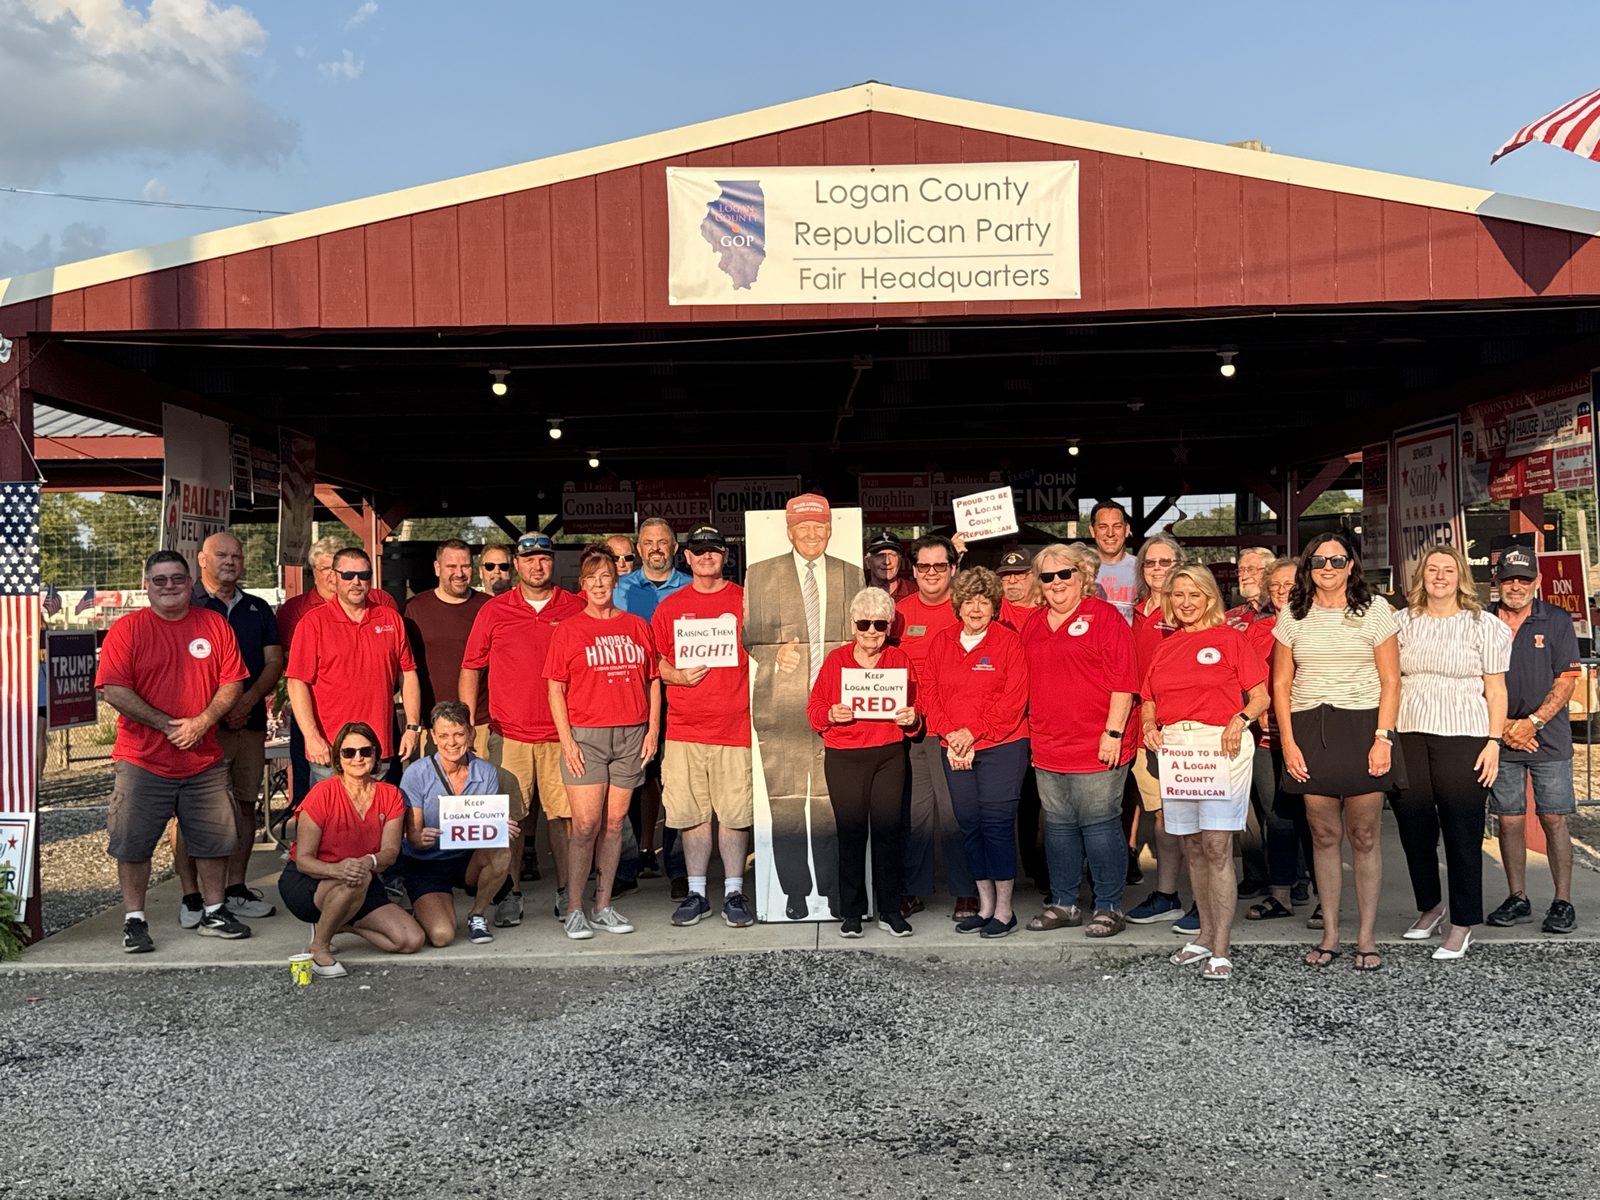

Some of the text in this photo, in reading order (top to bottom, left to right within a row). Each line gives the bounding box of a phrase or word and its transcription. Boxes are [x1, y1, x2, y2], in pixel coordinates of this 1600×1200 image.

[815, 176, 1029, 209] Logan County
[718, 204, 754, 213] LOGAN
[715, 213, 758, 222] COUNTY
[720, 235, 755, 247] GOP
[794, 217, 1051, 251] Republican Party
[799, 263, 1050, 293] Fair Headquarters
[1541, 412, 1573, 432] Landers
[1413, 445, 1433, 460] SENATOR
[1556, 444, 1592, 460] WRIGHT
[1034, 472, 1077, 487] JOHN
[1409, 464, 1439, 502] Sally
[183, 483, 229, 518] BAILEY
[564, 497, 633, 516] Conahan
[861, 490, 915, 512] Coughlin
[956, 497, 983, 508] PROUD
[638, 502, 708, 516] KNAUER
[965, 508, 972, 517] A
[968, 516, 1002, 527] COUNY
[181, 521, 198, 542] DEL
[963, 525, 1012, 540] REPUBLAN
[1402, 522, 1453, 561] TURNER
[1552, 579, 1573, 594] DON
[1547, 594, 1580, 612] TRACY
[677, 627, 734, 638] RAISING THEM
[595, 635, 634, 647] ANDREA
[585, 643, 645, 667] HINTON
[679, 643, 734, 658] RIGHT!
[51, 654, 94, 677] TRUMP
[864, 671, 885, 679] KEEP
[57, 676, 90, 695] VANCE
[844, 683, 904, 692] LOGAN COUNTY
[851, 696, 897, 712] RED
[1161, 747, 1194, 757] PROUD
[1171, 760, 1217, 770] A LOGAN
[1174, 774, 1215, 783] COUNTY
[1166, 786, 1225, 797] REPUBLICAN
[464, 799, 485, 807] KEEP
[443, 811, 505, 820] LOGAN COUNTY
[450, 824, 498, 842] RED
